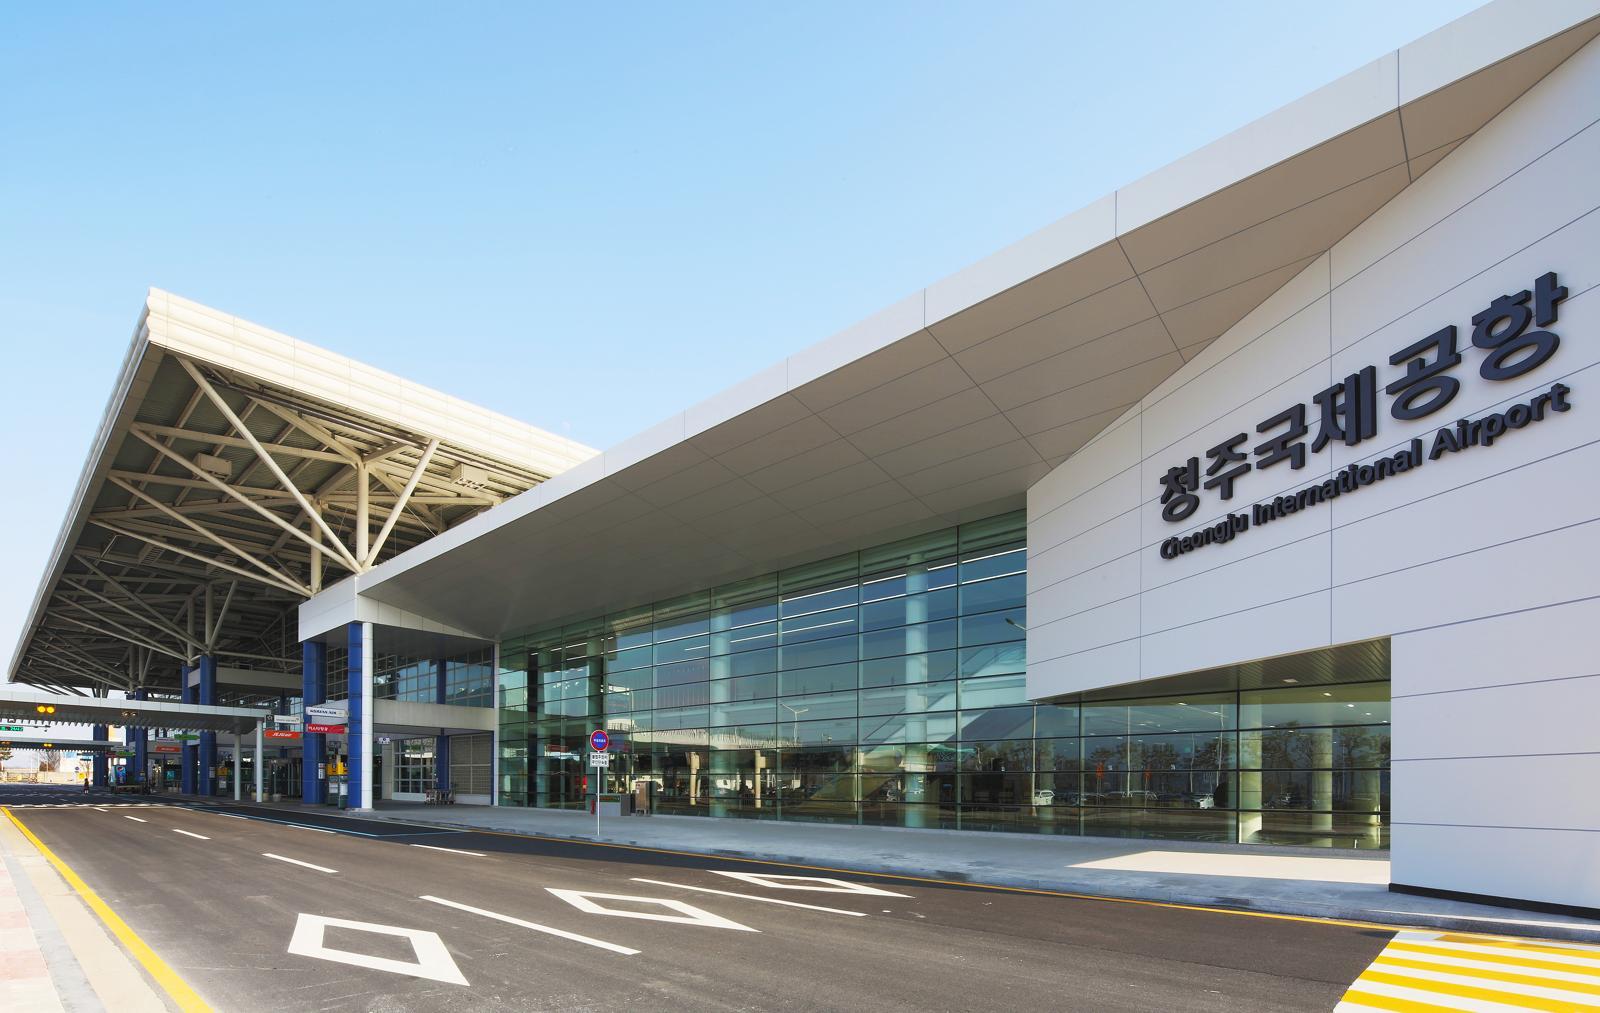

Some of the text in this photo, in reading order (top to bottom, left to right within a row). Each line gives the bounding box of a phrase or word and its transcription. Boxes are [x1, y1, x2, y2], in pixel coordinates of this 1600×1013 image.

[1159, 271, 1569, 523] 청주국제공항
[1159, 382, 1572, 560] Cheongju International Airport
